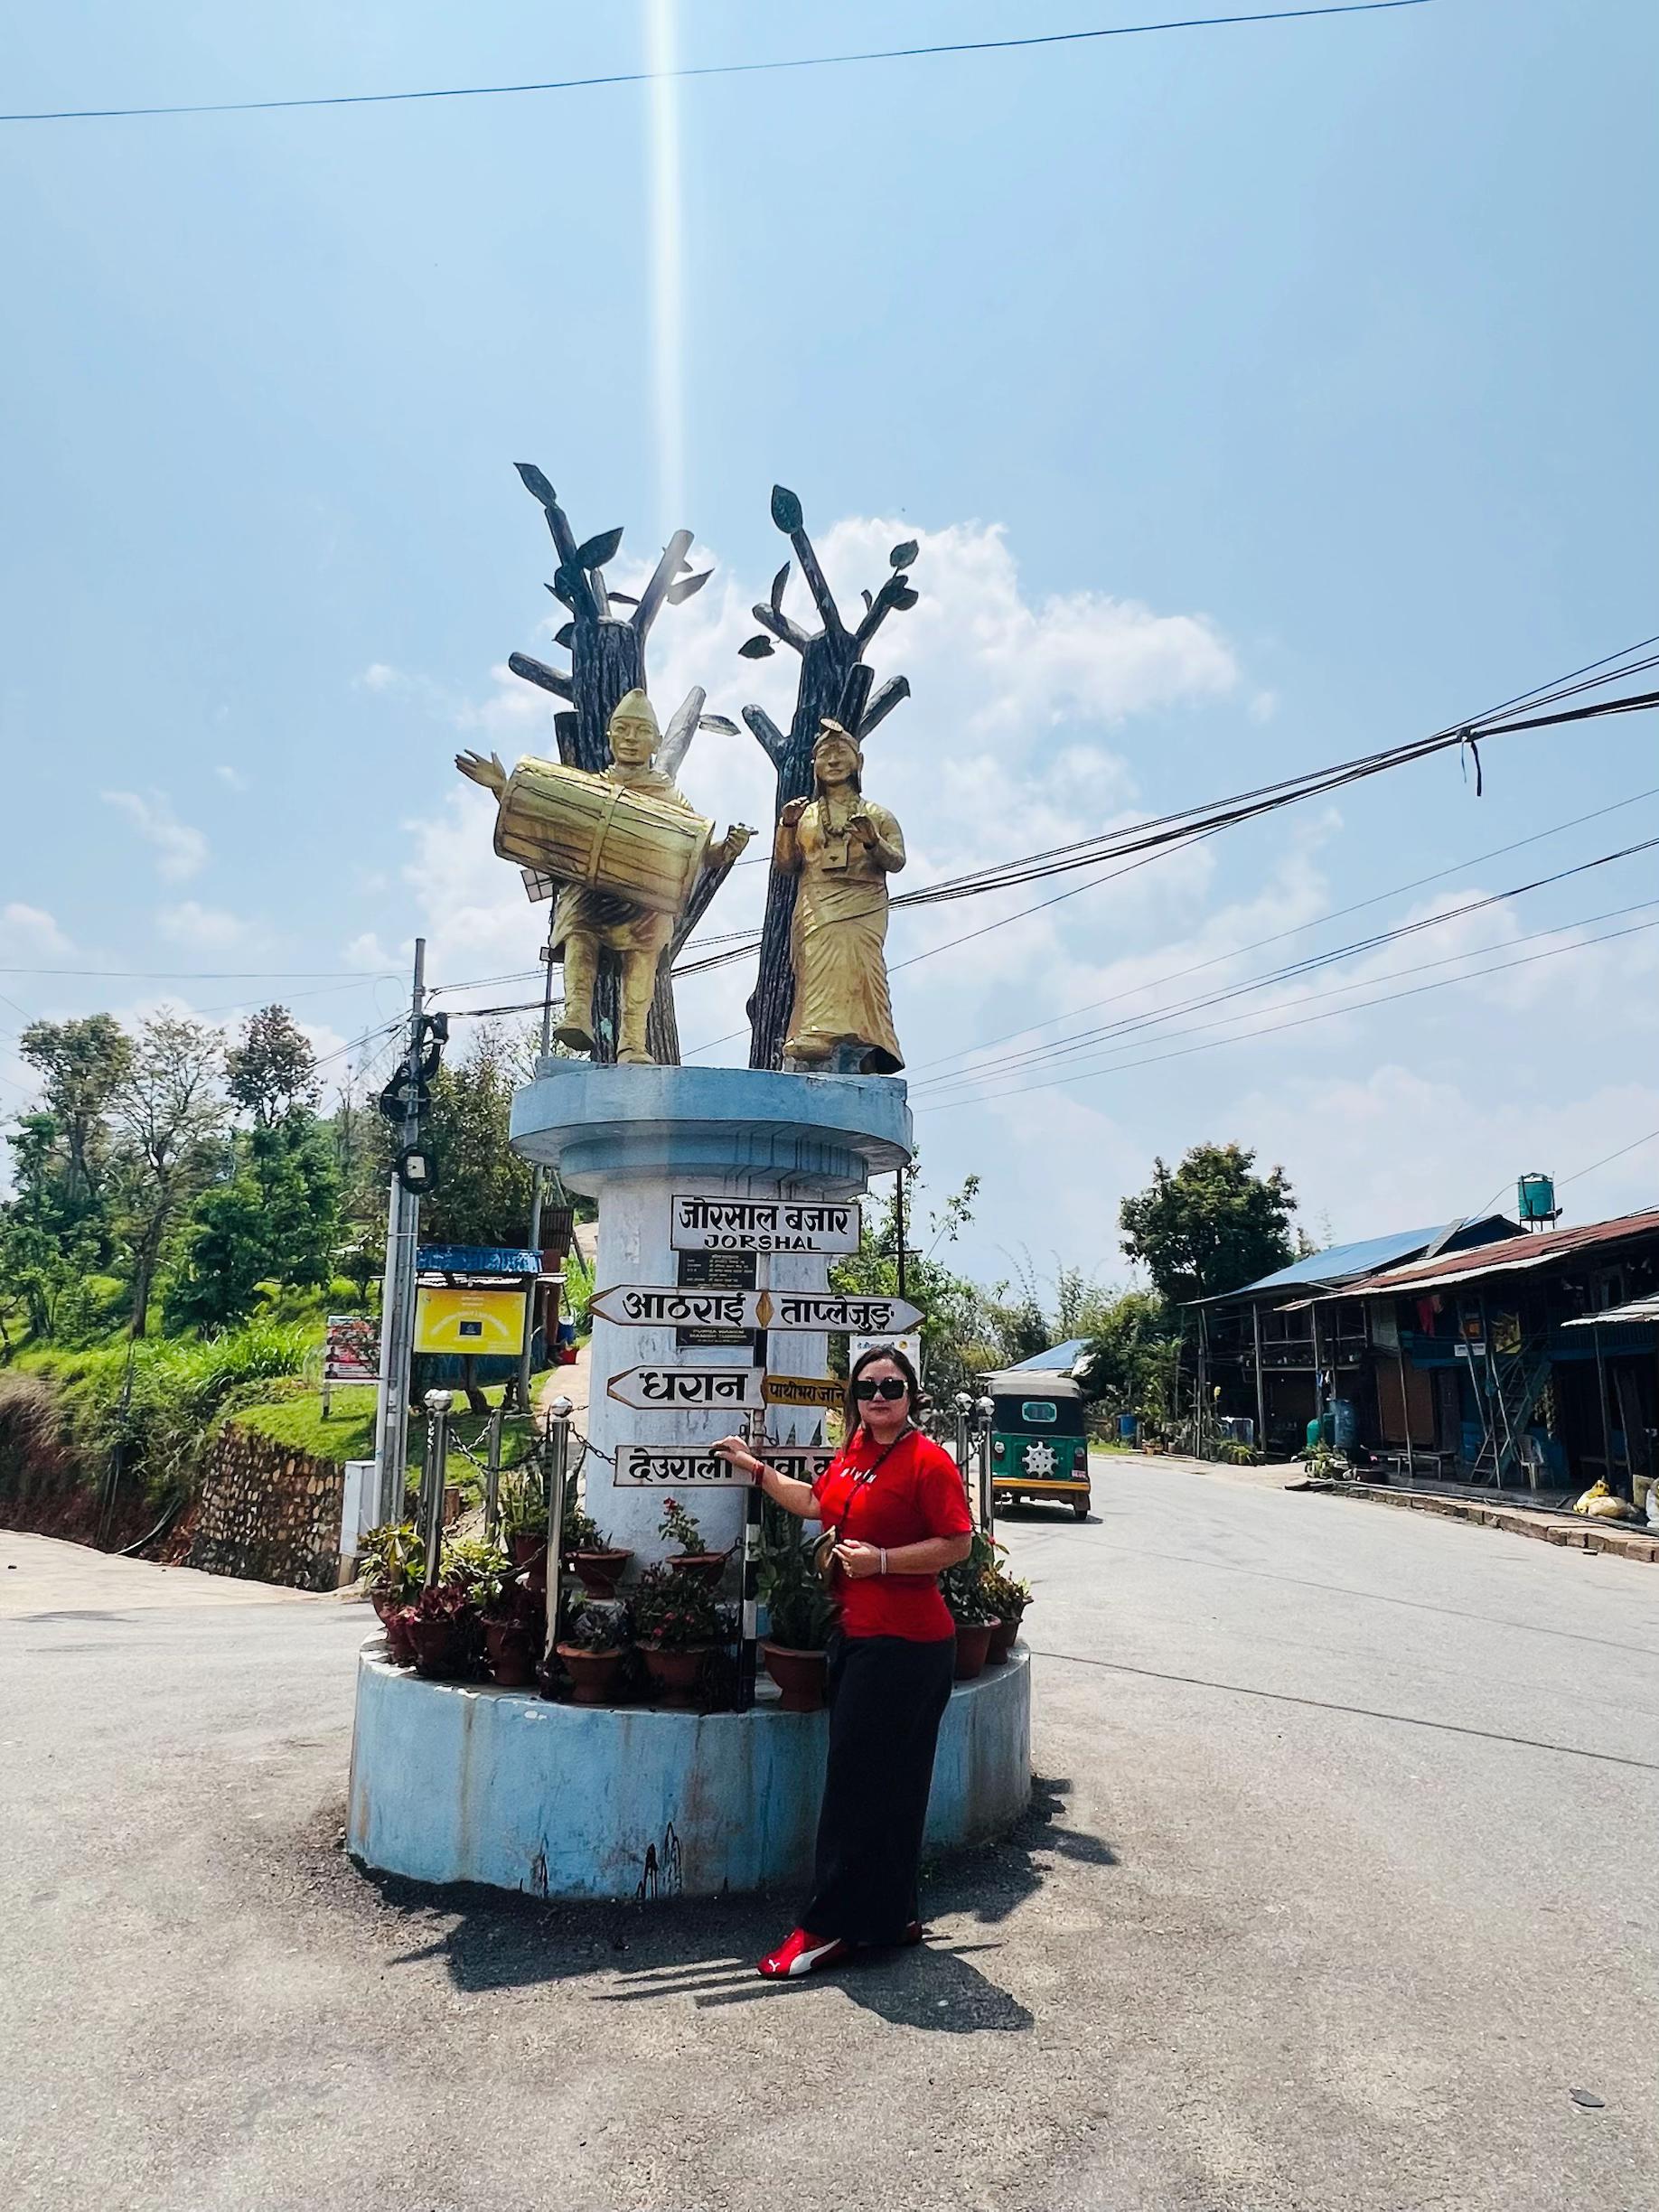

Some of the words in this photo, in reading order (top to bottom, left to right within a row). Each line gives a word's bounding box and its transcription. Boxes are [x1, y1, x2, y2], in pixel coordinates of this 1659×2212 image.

[680, 1197, 778, 1232] जोरसाल
[785, 1206, 851, 1235] बजार
[704, 1233, 821, 1251] JORSHAL
[622, 1291, 745, 1326] आठराई
[639, 1372, 748, 1403] धरान
[769, 1381, 816, 1401] पाथीभरा
